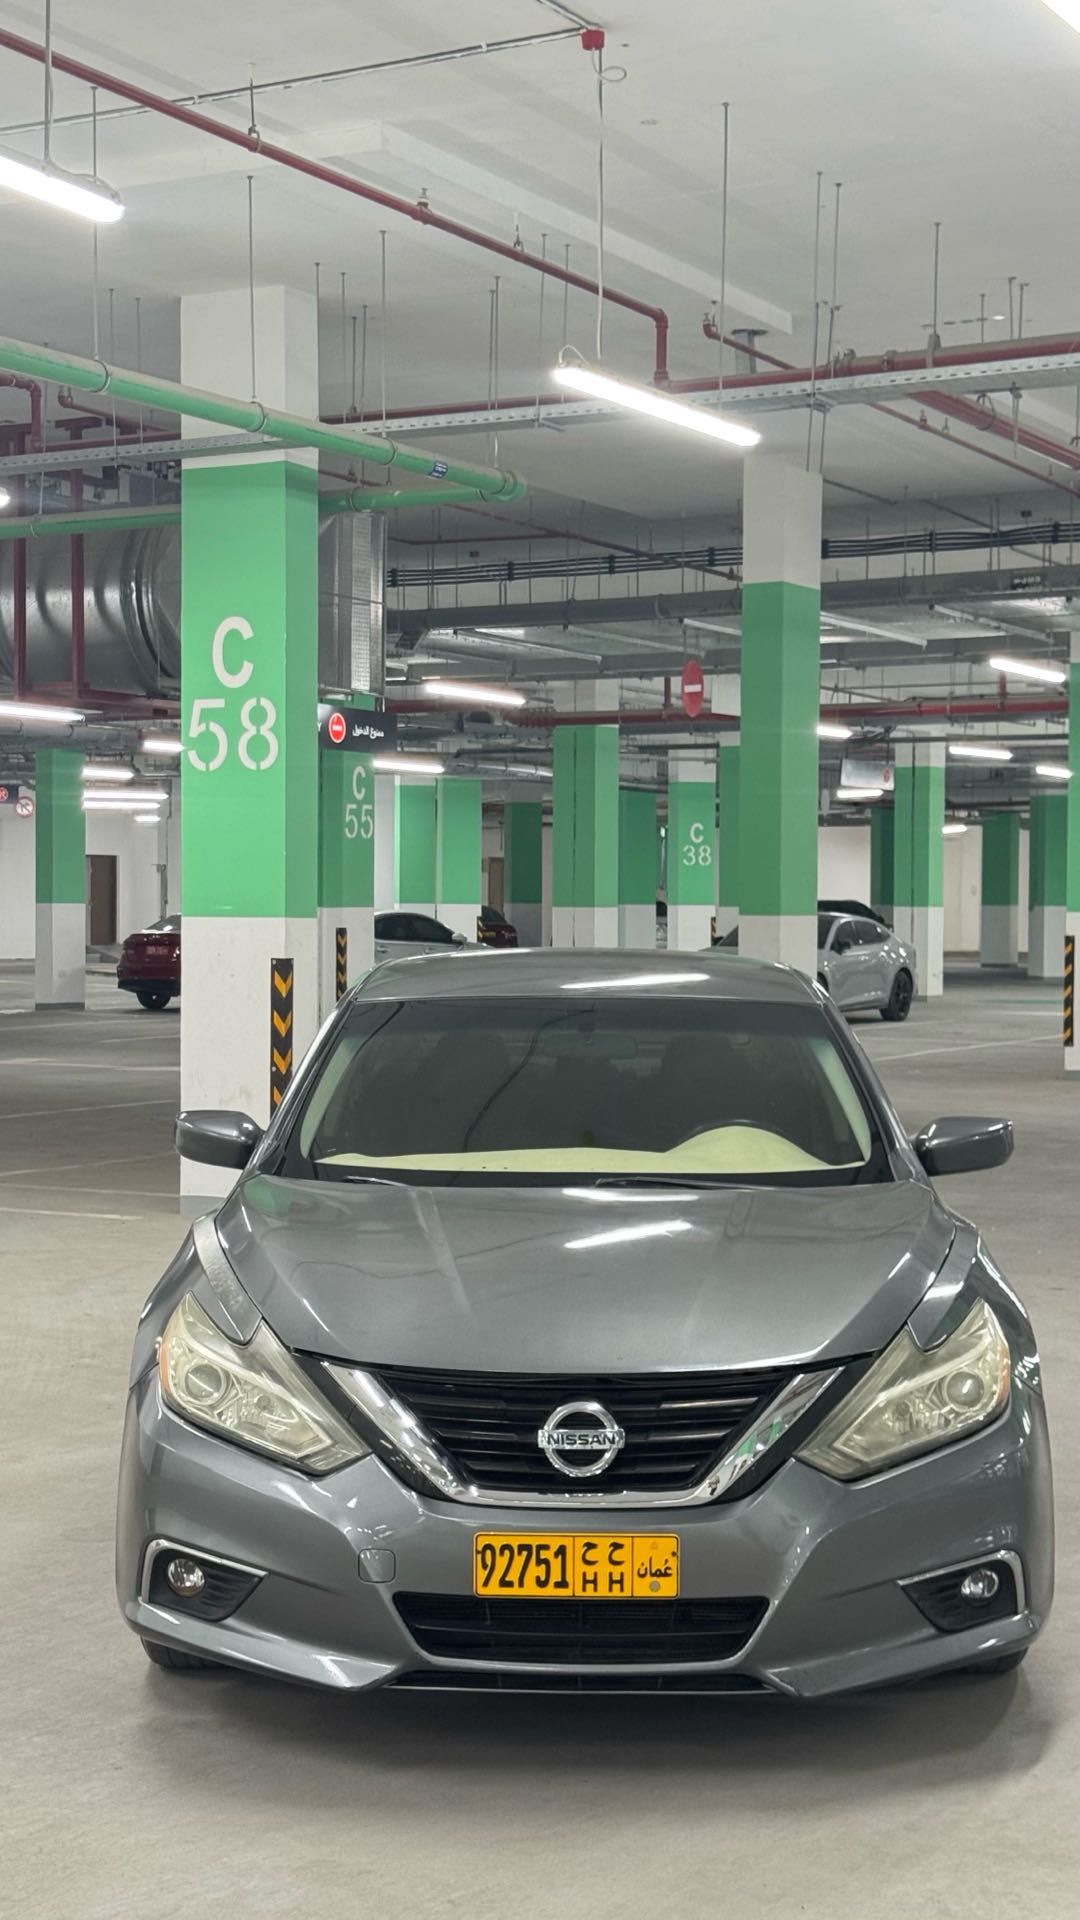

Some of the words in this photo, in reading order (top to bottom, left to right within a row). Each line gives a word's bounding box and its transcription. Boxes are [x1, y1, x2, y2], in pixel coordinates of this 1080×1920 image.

[212, 616, 255, 689] C
[187, 697, 279, 772] 58
[352, 765, 366, 800] C
[345, 803, 373, 839] 55
[690, 822, 704, 843] C
[683, 844, 711, 866] 38
[547, 1433, 616, 1446] NISSAN
[480, 1543, 569, 1589] 92751
